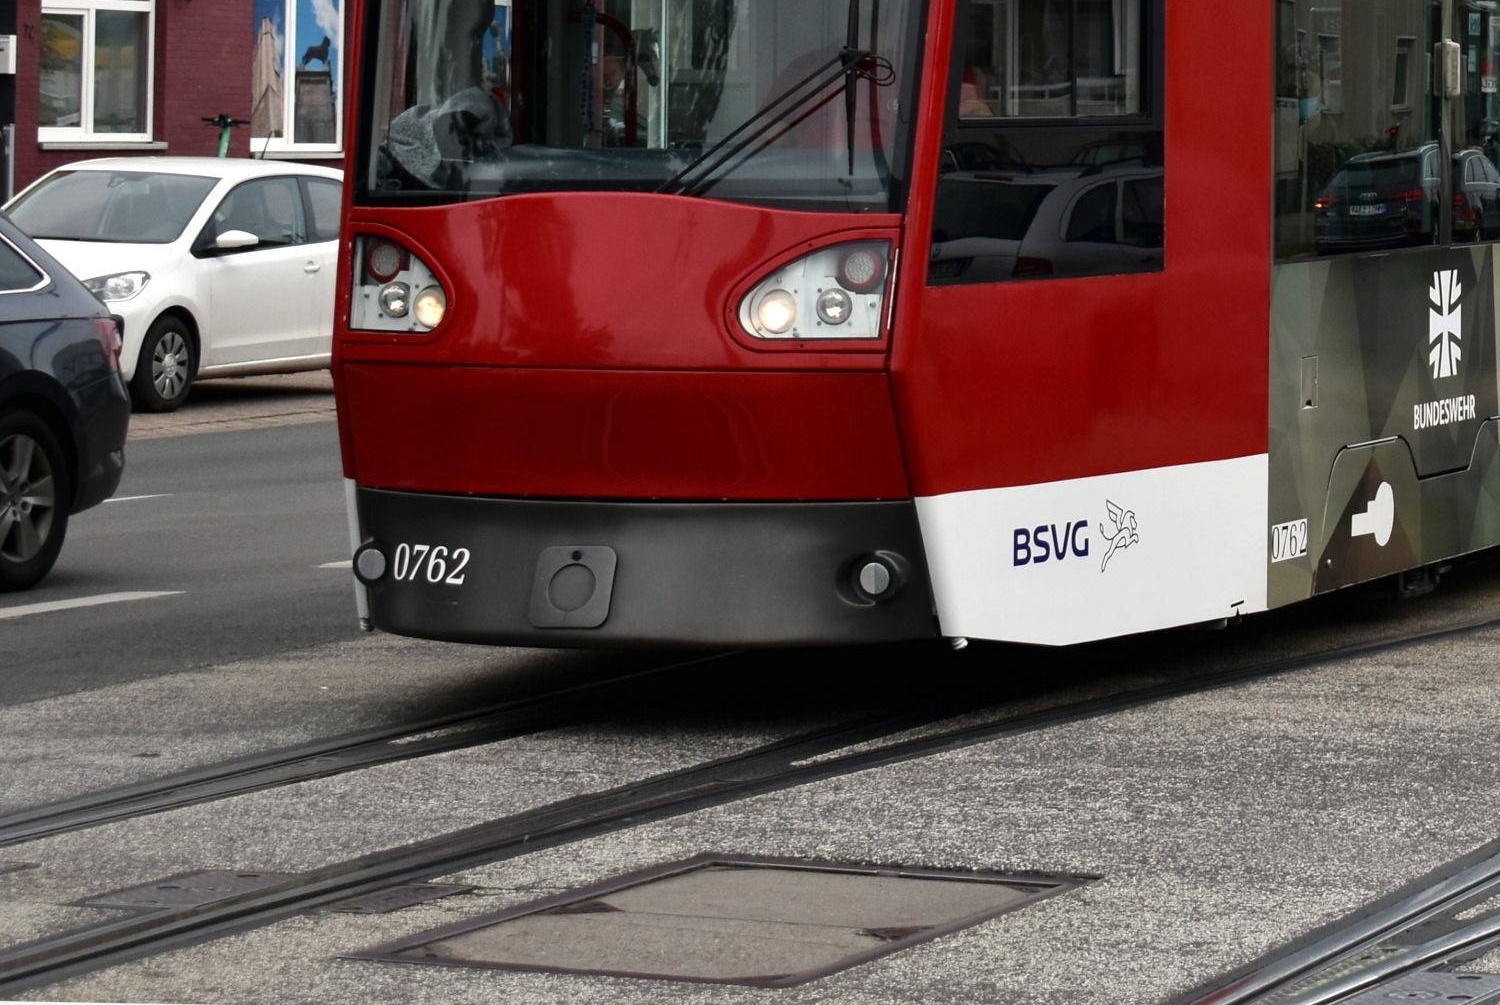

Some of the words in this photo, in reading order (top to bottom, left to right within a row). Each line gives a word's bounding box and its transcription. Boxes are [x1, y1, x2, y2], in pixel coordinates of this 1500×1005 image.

[1413, 394, 1476, 430] BUNDESWEHR
[1013, 520, 1089, 567] BSVG
[1272, 520, 1307, 562] 0762
[393, 543, 471, 585] 0762
